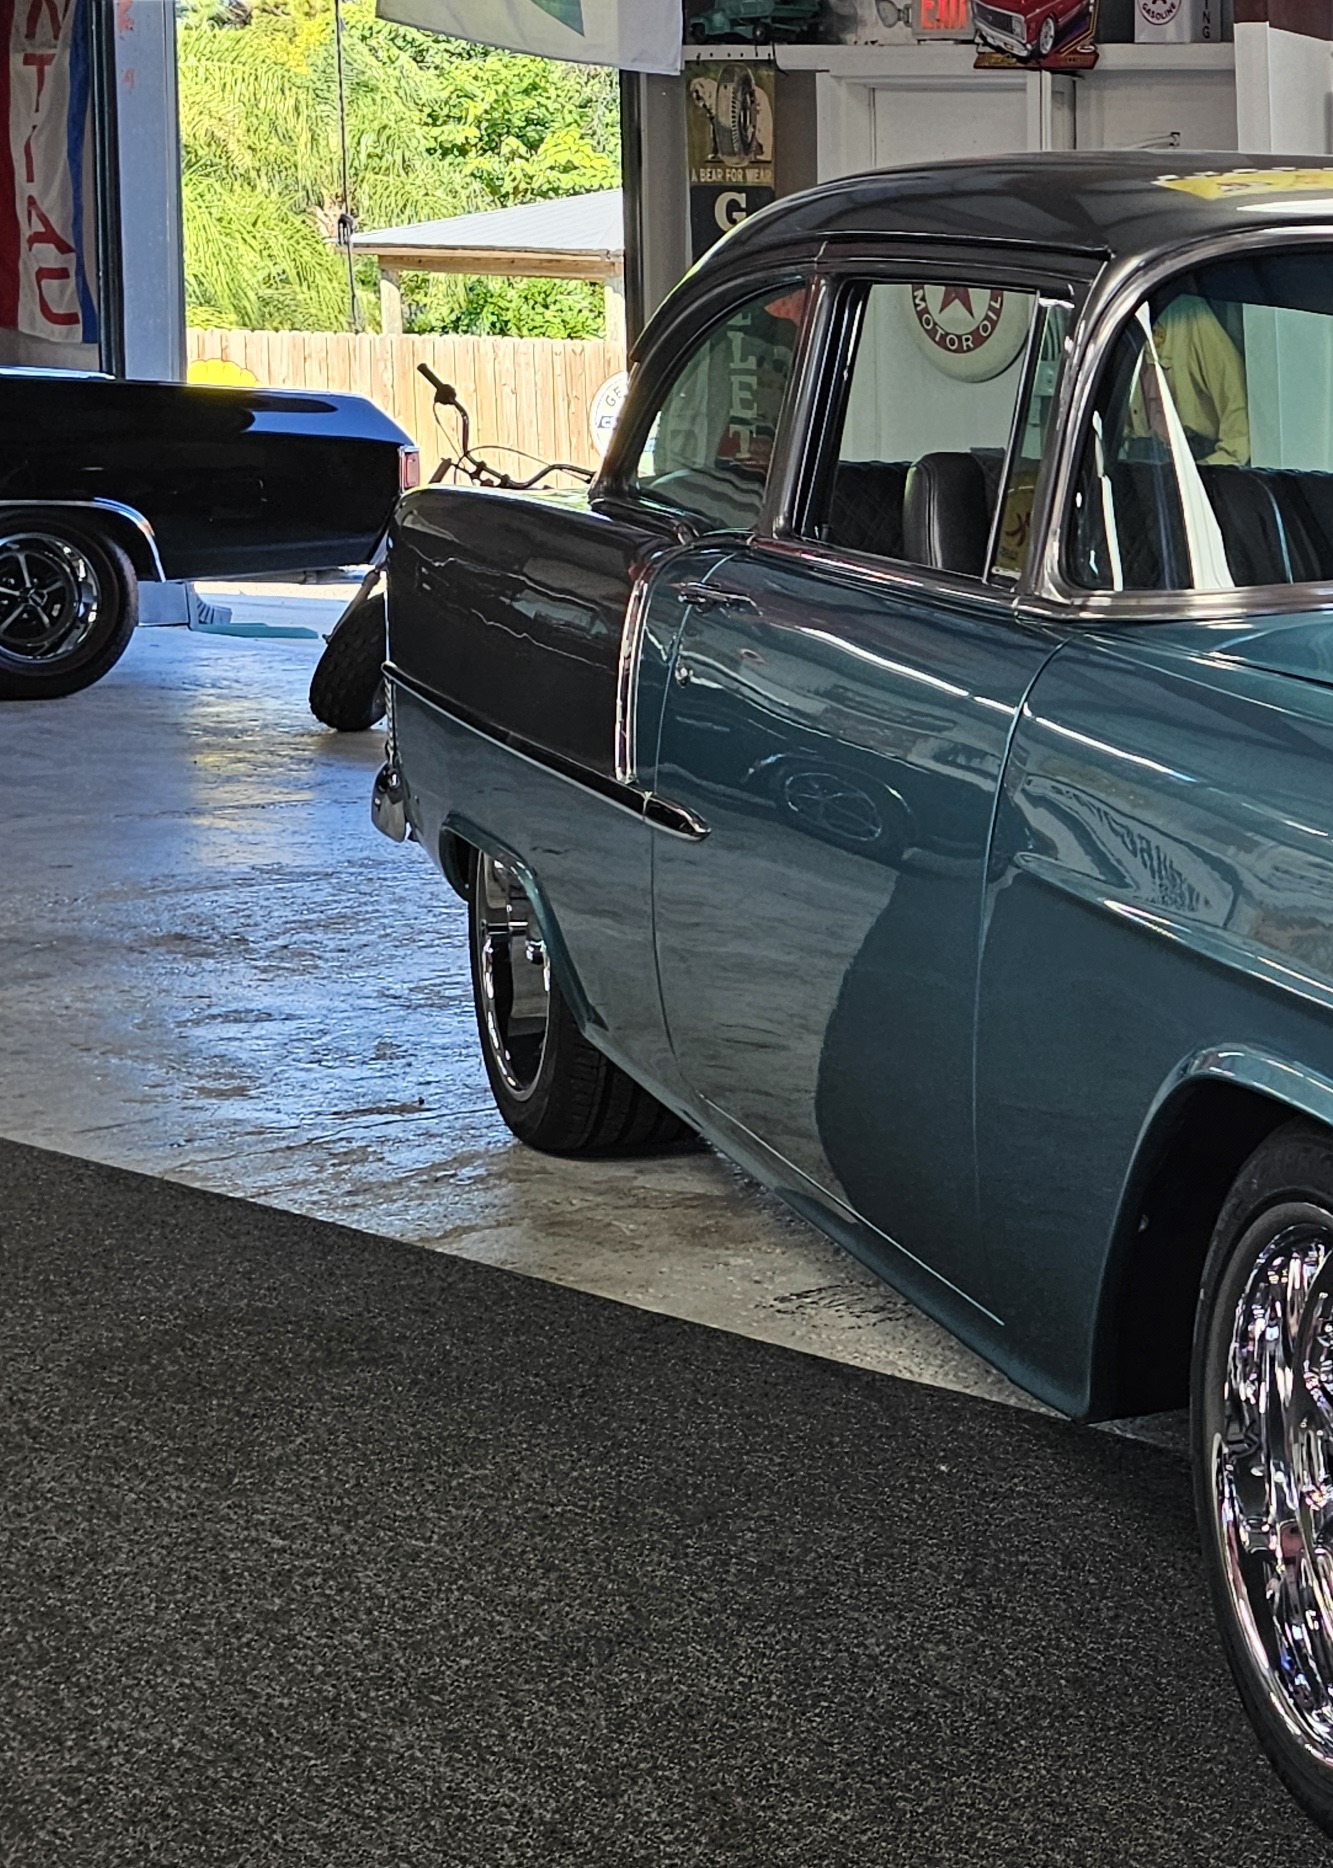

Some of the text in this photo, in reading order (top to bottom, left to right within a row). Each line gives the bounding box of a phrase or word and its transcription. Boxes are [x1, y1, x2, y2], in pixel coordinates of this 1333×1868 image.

[1142, 2, 1176, 21] GASOLINE
[691, 168, 773, 182] A BEAR FOR WEAR
[913, 289, 1002, 351] MOTOR OIL
